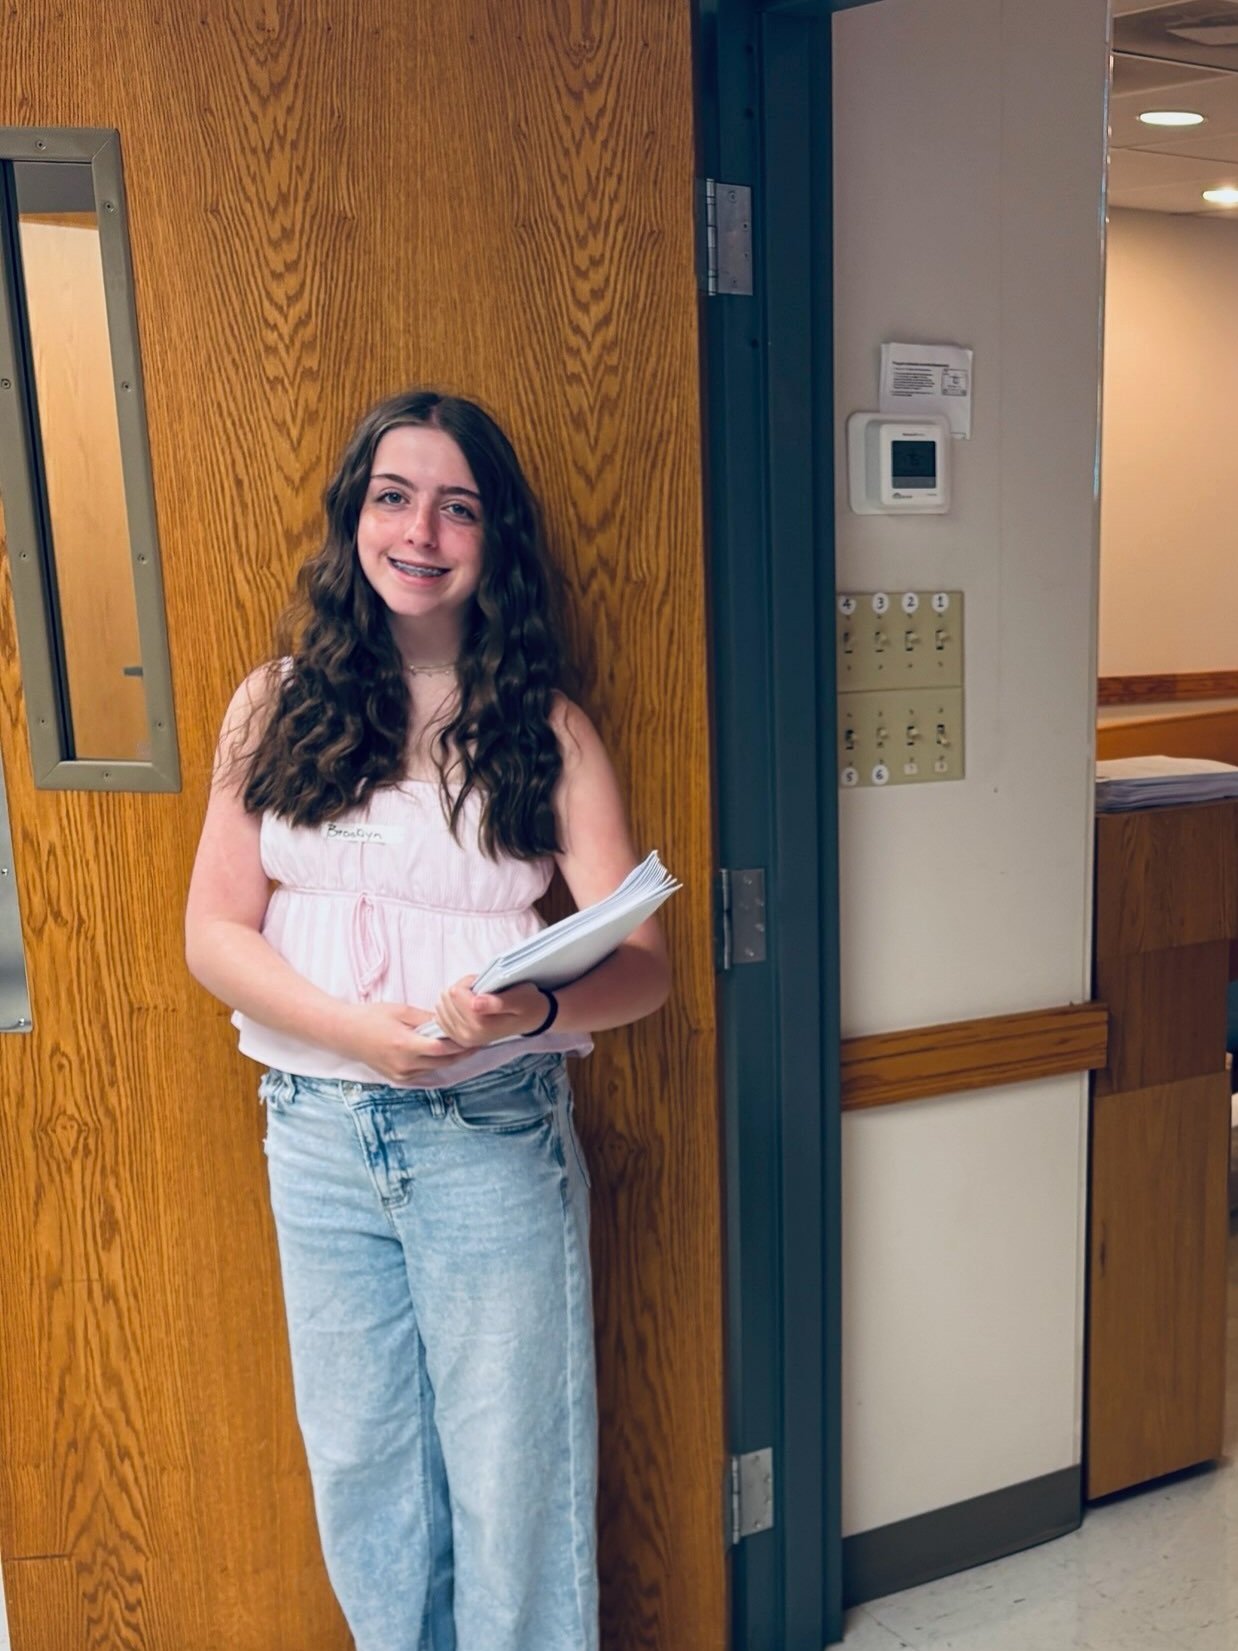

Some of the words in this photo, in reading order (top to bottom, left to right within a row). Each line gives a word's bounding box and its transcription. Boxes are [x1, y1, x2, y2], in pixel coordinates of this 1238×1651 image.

[843, 598, 851, 609] 4
[877, 597, 884, 609] 3
[907, 596, 915, 607] 2
[937, 596, 944, 607] 1
[846, 771, 853, 782] 5
[876, 769, 883, 780] 6
